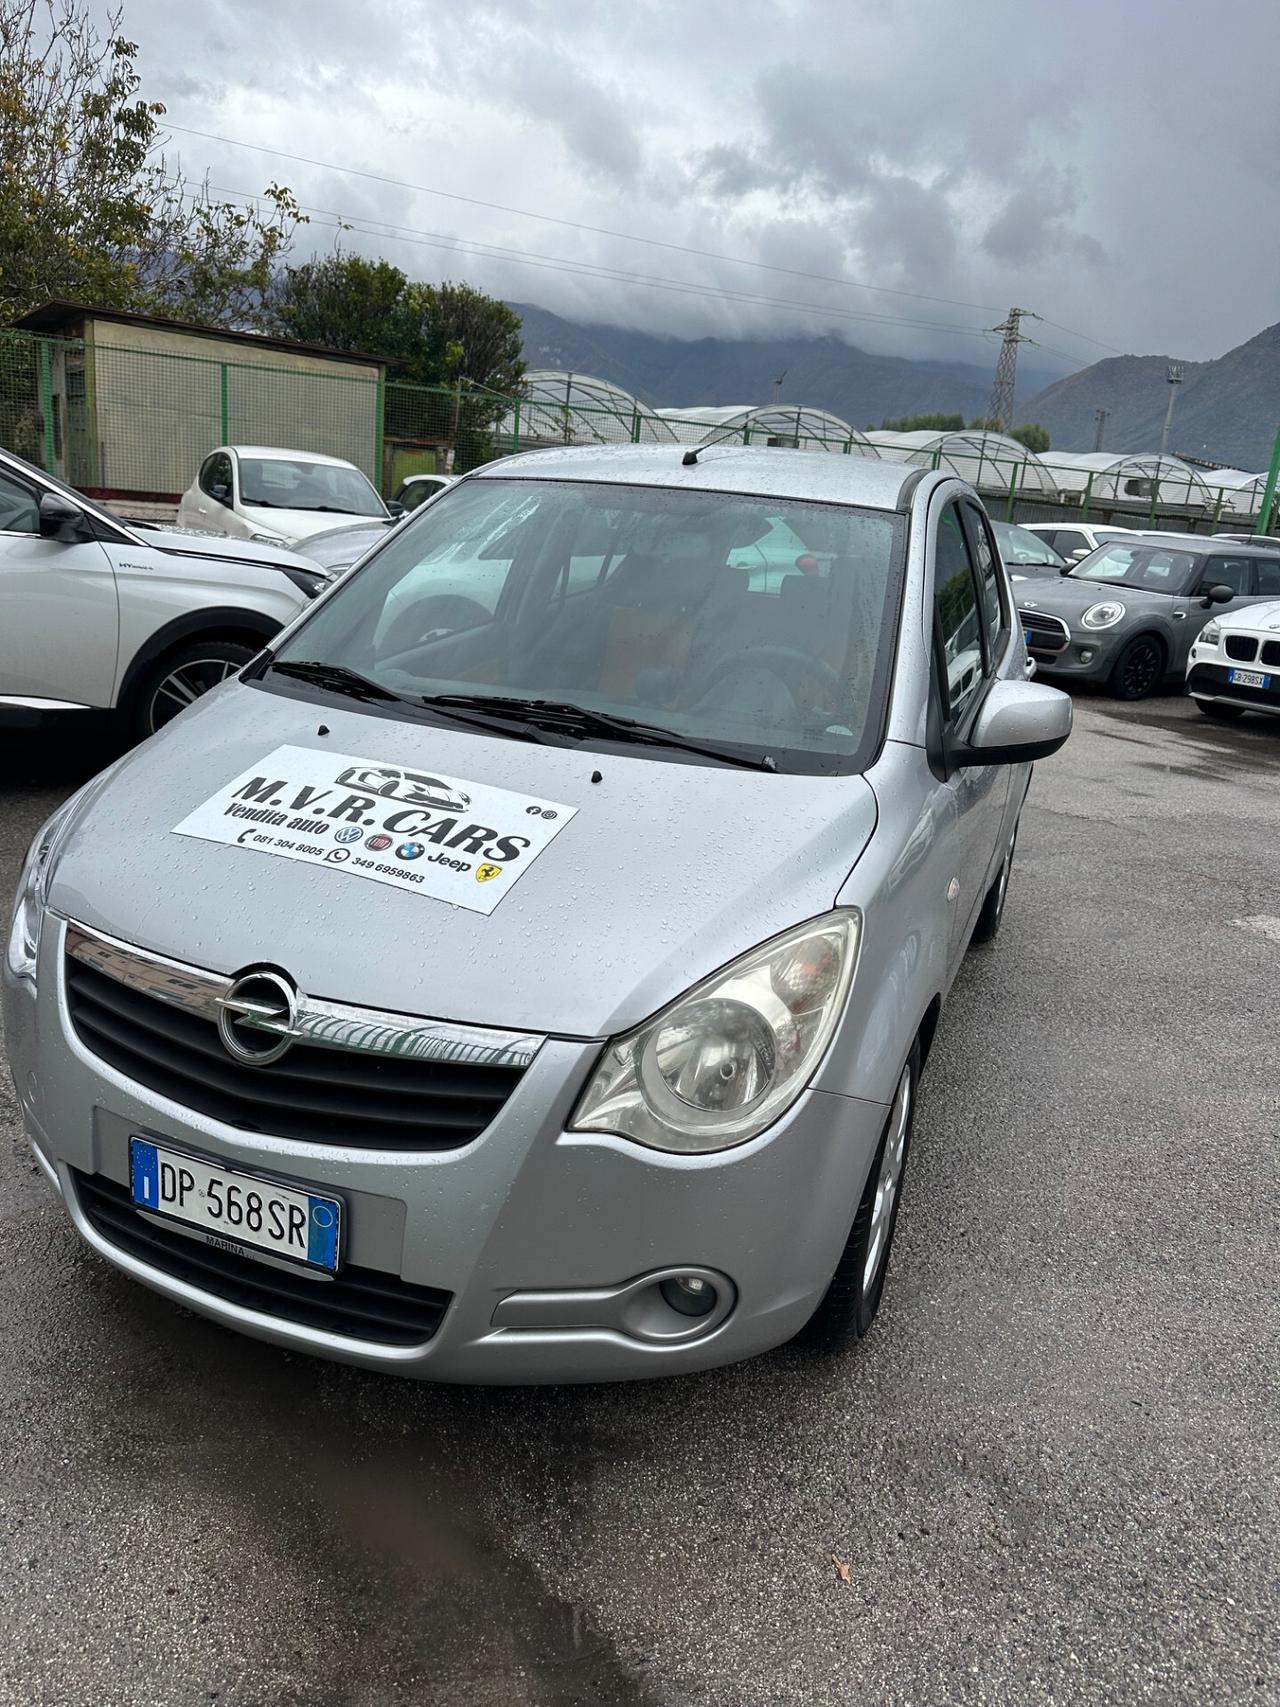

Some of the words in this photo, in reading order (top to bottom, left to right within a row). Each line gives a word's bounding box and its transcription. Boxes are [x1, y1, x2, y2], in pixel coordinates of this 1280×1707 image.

[223, 802, 288, 826] Vendita
[286, 817, 330, 835] auto
[252, 834, 274, 844] 081
[274, 839, 296, 850] 304
[295, 843, 325, 856] 8005
[351, 857, 374, 869] 349
[374, 863, 425, 884] 6959863
[427, 852, 472, 873] Jeep
[205, 1235, 245, 1257] MARINA
